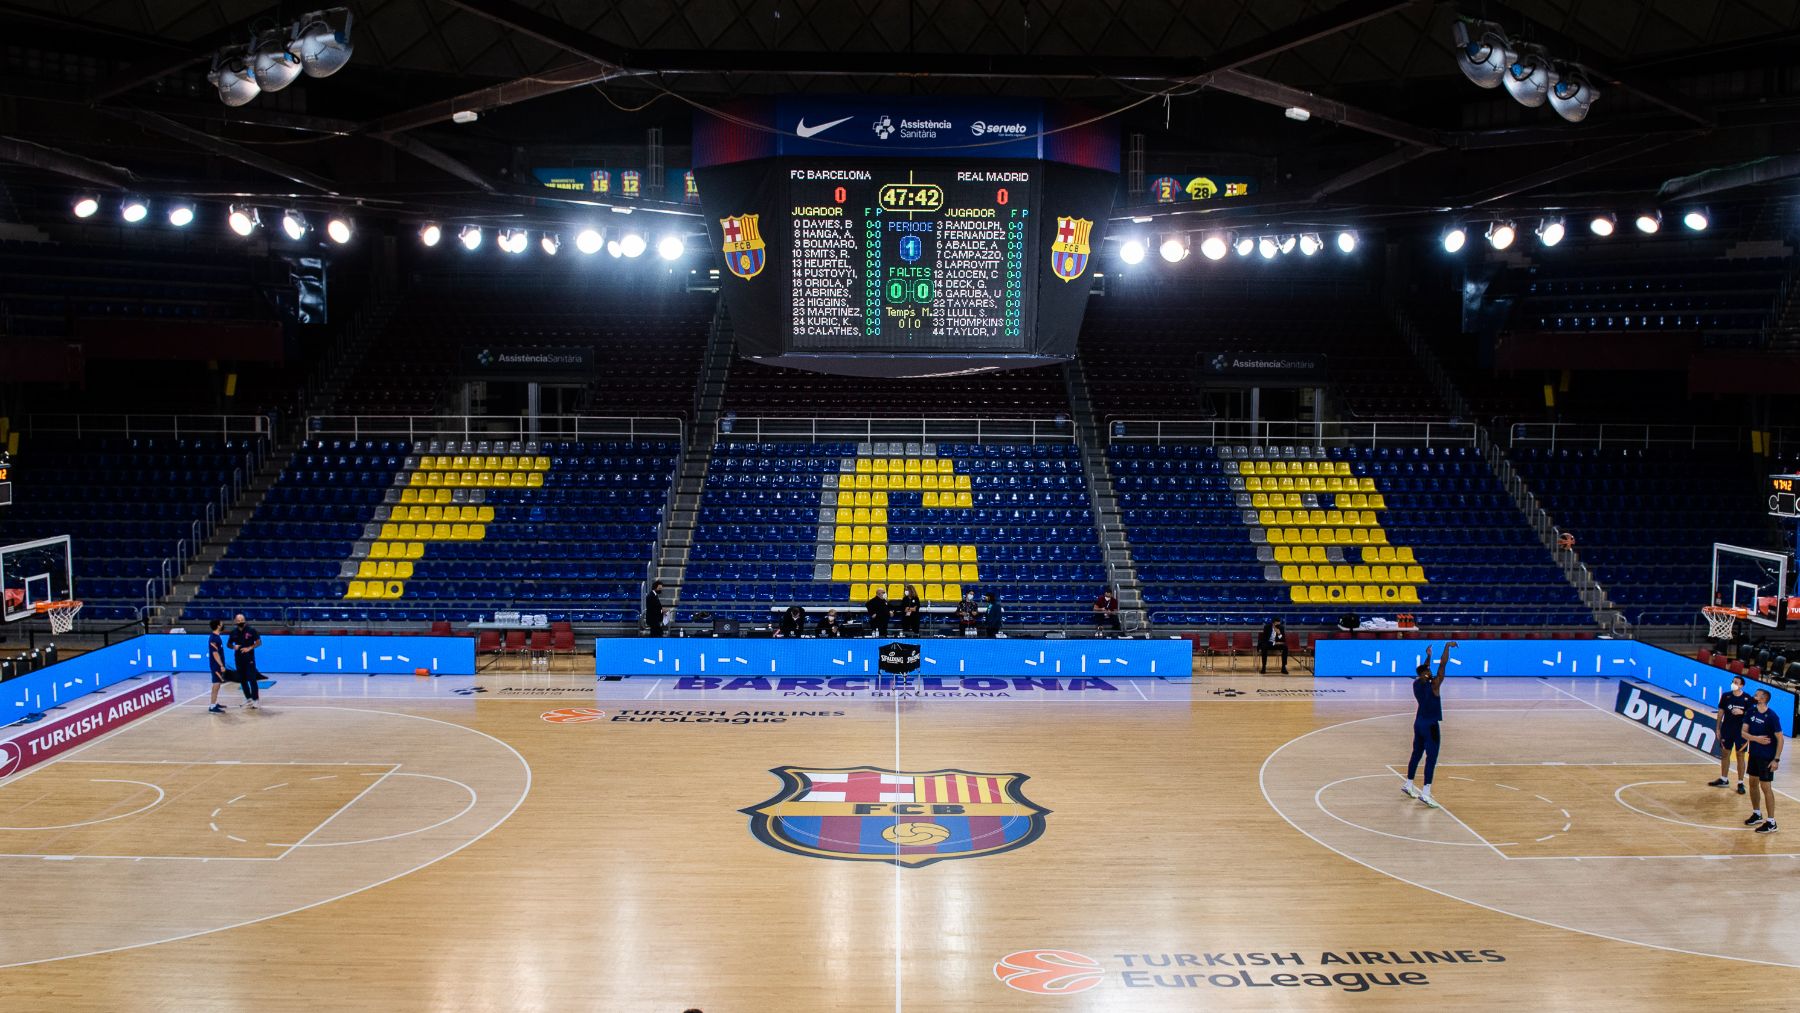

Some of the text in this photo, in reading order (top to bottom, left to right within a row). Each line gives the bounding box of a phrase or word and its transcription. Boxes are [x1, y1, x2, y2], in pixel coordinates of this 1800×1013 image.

[900, 119, 952, 129] Assistència
[987, 123, 1026, 133] serveto
[900, 129, 937, 139] Sanitària
[791, 170, 871, 180] FC BARCELONA
[958, 172, 1028, 182] REAL MADRID
[593, 180, 608, 192] 15
[624, 180, 638, 192] 12
[834, 186, 846, 203] 0
[884, 189, 939, 206] 47:42
[997, 189, 1008, 204] 0
[1194, 188, 1209, 198] 28
[792, 207, 882, 216] JUGADOR F P
[945, 209, 995, 217] JUGADOR
[793, 220, 881, 230] 0 DAVIES, B 0-0
[888, 222, 932, 231] PERIODE
[936, 221, 1023, 231] 3 RANDOLPH, 0-0
[794, 229, 881, 239] 8 HANGA, A. 0-0
[936, 231, 1022, 240] 5 FERNANDEZ 0-0
[735, 242, 751, 250] FCB
[803, 239, 858, 250] BOLMARO,
[866, 240, 881, 249] 0-0
[906, 241, 915, 256] 1
[936, 241, 1022, 250] 6 ABALDE, A 0-0
[1064, 244, 1078, 252] FCB
[792, 249, 881, 259] 10 SMITS, R. 0-0
[936, 251, 1022, 260] 7 CAMPAZZO, 0-0
[792, 259, 881, 269] 13 HEURTEL, 0-0
[936, 261, 942, 269] 8
[944, 261, 1000, 269] LAPROVITT
[792, 269, 802, 277] 14
[866, 269, 881, 278] 0-0
[889, 268, 931, 277] FALTES
[934, 270, 1021, 280] 12 ALOCEN, C 0-0
[792, 279, 881, 288] 18 ORIOLA, P 0-0
[934, 280, 1021, 289] 14 DECK, G. 0-0
[792, 288, 881, 298] 21 ABRINES, 0-0
[890, 283, 928, 298] 0 0
[934, 290, 1020, 299] 16 GARUBA, U 0-0
[792, 298, 881, 308] 22 HIGGINS, 0-0
[933, 300, 1020, 309] 22 TAVARES, 0-0
[793, 308, 881, 317] 23 MARTINEZ, 0-0
[886, 307, 932, 318] Temps M.
[932, 309, 945, 317] 23
[947, 309, 977, 318] LLULL,
[979, 309, 988, 317] S.
[793, 317, 881, 327] 24 KURIC, K. 0-0
[932, 318, 945, 327] 33
[946, 318, 1004, 327] THOMPKINS
[807, 327, 862, 336] CALATHES,
[932, 328, 944, 336] 44
[946, 328, 989, 337] TAYLOR,
[991, 328, 997, 336] J
[881, 654, 904, 664] SPALDING
[674, 677, 1118, 691] BARCELONA
[28, 684, 171, 755] TURKISH AIRLINES
[610, 715, 788, 725] EuroLeague
[1623, 688, 1716, 754] bwin
[855, 803, 964, 815] FCB
[1114, 949, 1506, 967] TURKISH AIRLINES
[1122, 968, 1429, 993] EuroLeague
